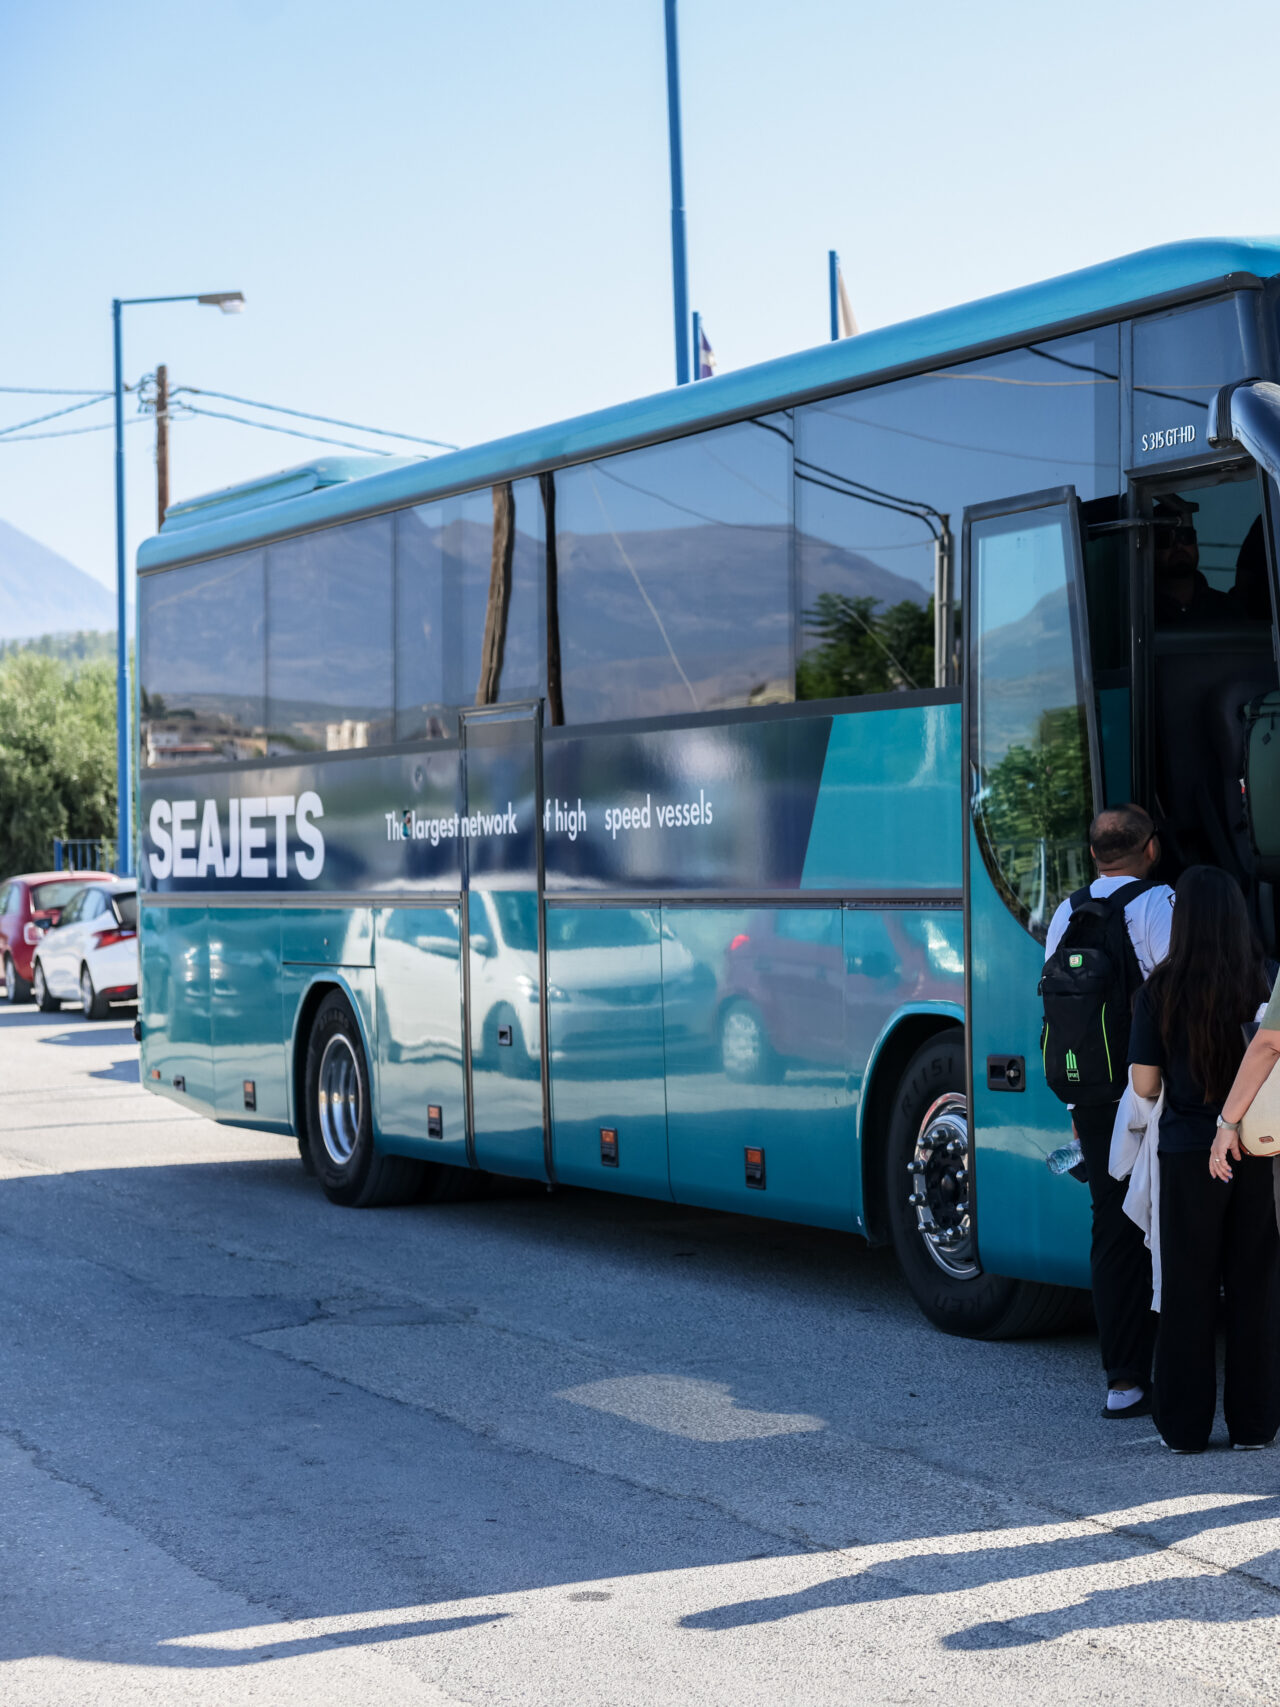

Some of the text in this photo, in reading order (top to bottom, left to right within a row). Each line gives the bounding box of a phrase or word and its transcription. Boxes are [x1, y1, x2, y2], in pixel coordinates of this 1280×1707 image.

[1142, 425, 1195, 451] S 315 GT-HD
[148, 790, 325, 881] SEAJETS
[412, 811, 460, 847] largest
[461, 802, 518, 837] network
[543, 798, 551, 832] f
[555, 798, 587, 841] high
[605, 793, 651, 840] speed
[656, 789, 713, 828] vessels
